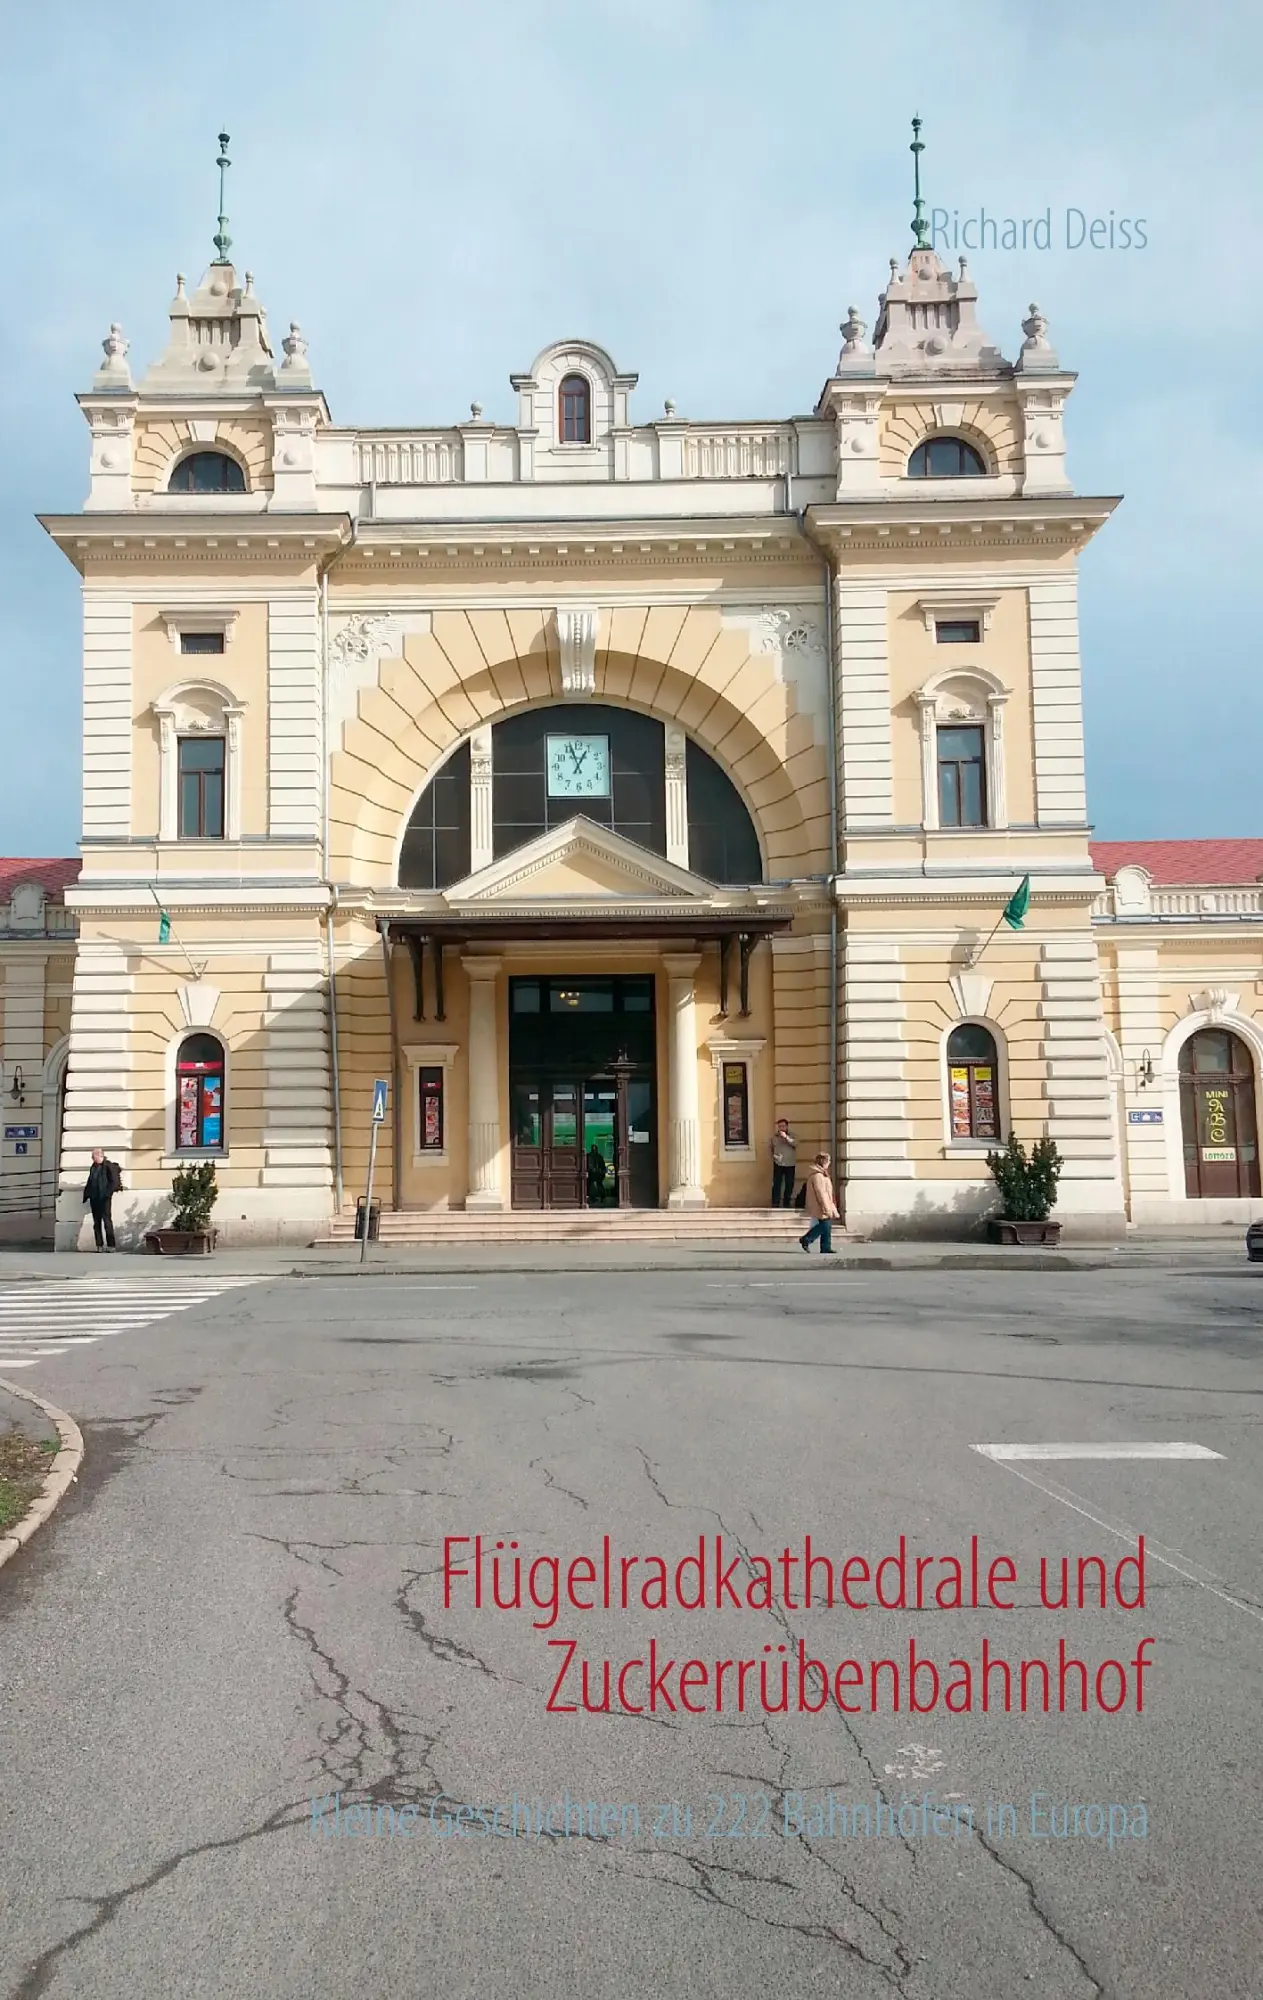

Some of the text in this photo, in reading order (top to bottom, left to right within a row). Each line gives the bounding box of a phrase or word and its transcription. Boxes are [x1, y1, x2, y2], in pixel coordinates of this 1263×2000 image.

[575, 740, 583, 750] 12
[557, 753, 566, 762] 10
[597, 762, 603, 771] 3
[565, 779, 571, 788] 7
[576, 782, 583, 791] 6
[1205, 1090, 1228, 1098] MINI
